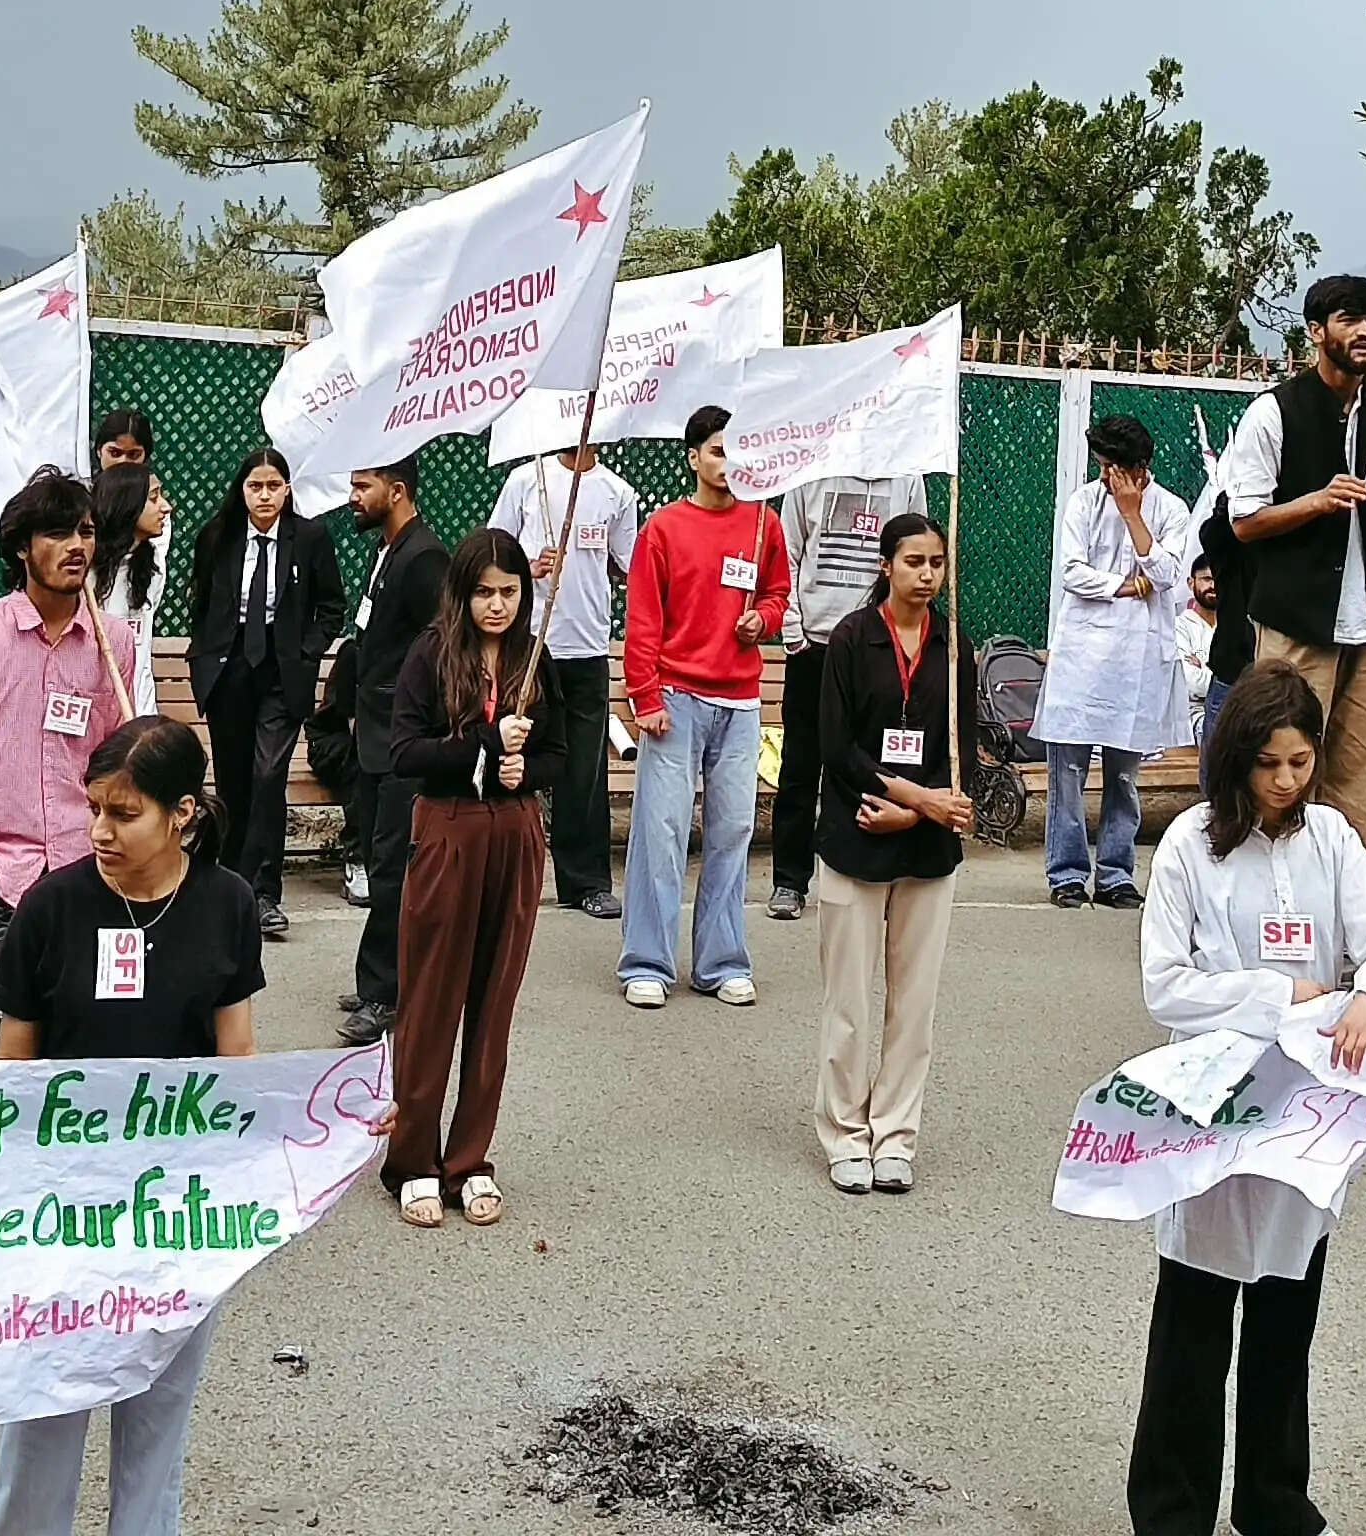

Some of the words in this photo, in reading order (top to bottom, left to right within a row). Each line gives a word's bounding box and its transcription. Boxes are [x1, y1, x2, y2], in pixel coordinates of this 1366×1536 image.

[579, 527, 606, 540] SFI
[856, 514, 877, 532] SFI
[725, 563, 754, 580] SFI
[50, 699, 88, 723] SFI
[887, 735, 921, 752] SFI
[1263, 921, 1312, 944] SFI
[114, 932, 137, 992] SFI
[36, 1070, 109, 1147] Fee
[33, 1192, 128, 1248] Our
